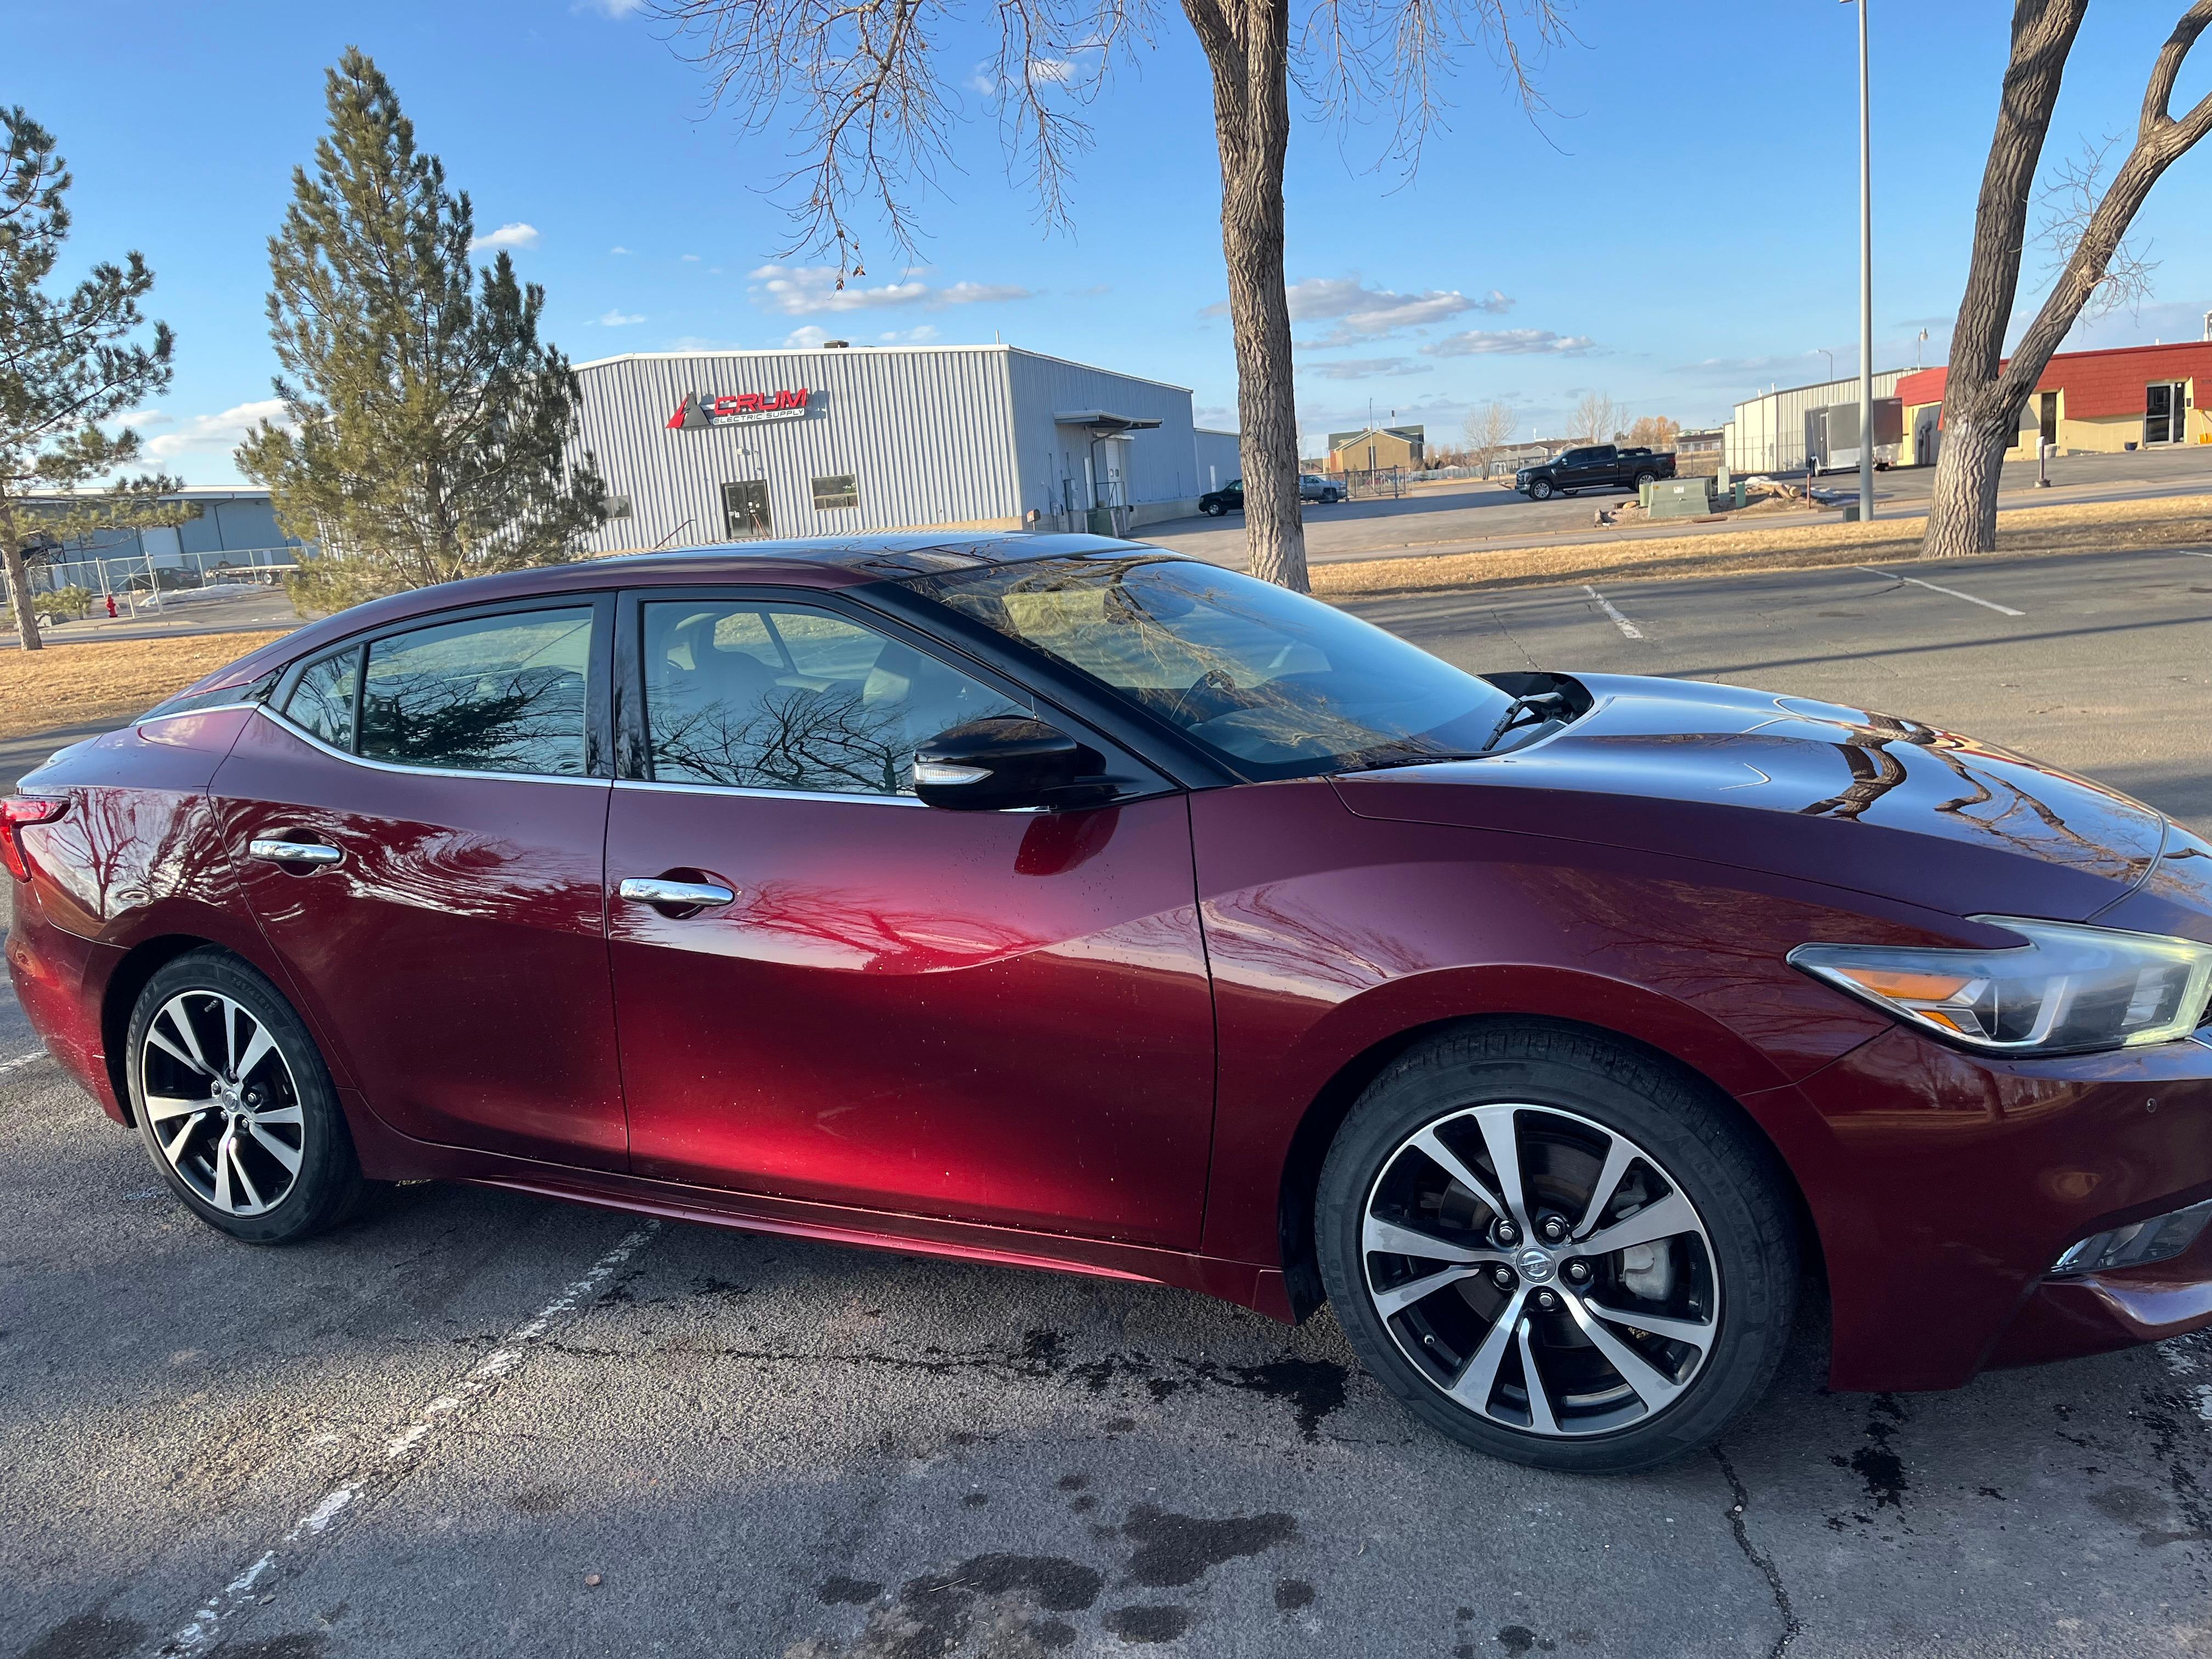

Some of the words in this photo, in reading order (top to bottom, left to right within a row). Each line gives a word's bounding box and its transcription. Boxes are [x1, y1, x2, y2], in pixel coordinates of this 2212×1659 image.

[715, 388, 808, 415] CRUM
[714, 414, 763, 424] ELECTRIC
[766, 409, 804, 419] SUPPLY
